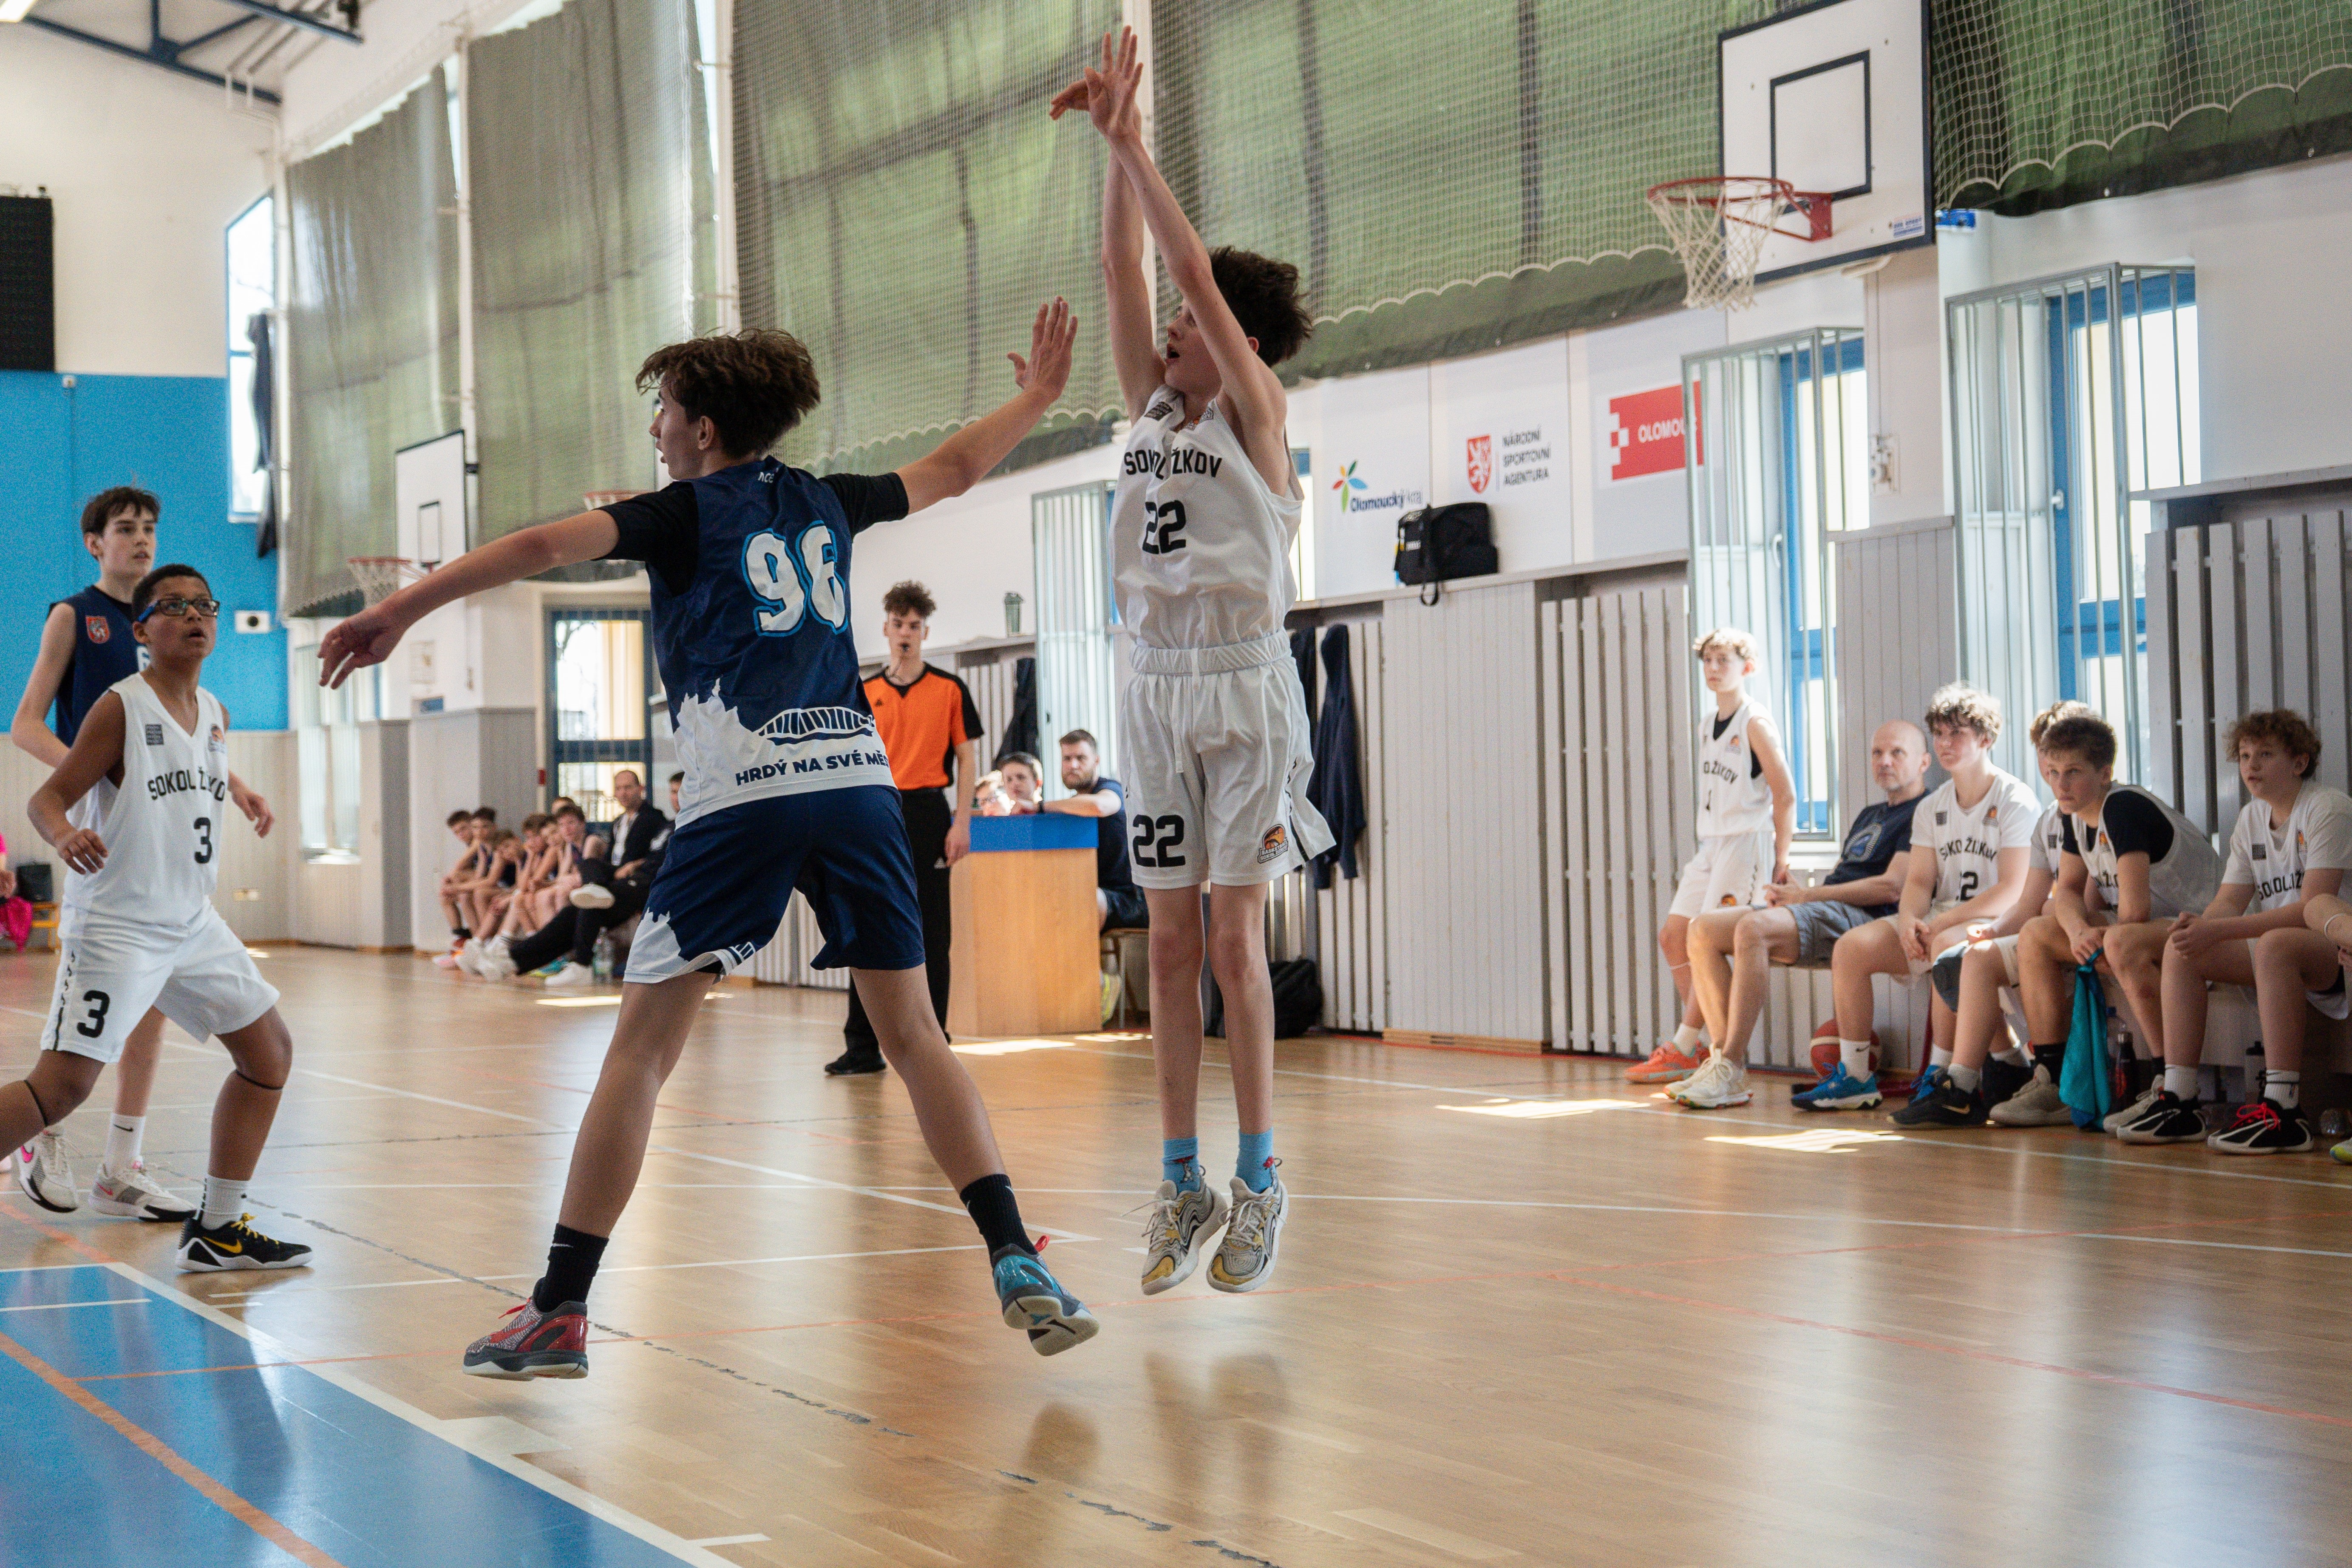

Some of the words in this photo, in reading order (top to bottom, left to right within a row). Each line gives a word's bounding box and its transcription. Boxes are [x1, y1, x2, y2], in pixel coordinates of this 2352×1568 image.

[1171, 447, 1222, 478] ŽKOV
[1142, 500, 1186, 555] 22
[741, 520, 848, 637] 96
[147, 770, 196, 800] SOKOL
[735, 759, 788, 785] HRDÝ
[794, 758, 823, 773] NA
[825, 750, 863, 769] SVÉ
[864, 750, 889, 768] MĚS
[193, 817, 213, 864] 3
[1132, 814, 1185, 868] 22
[1956, 871, 1978, 902] 2
[77, 990, 110, 1038] 3
